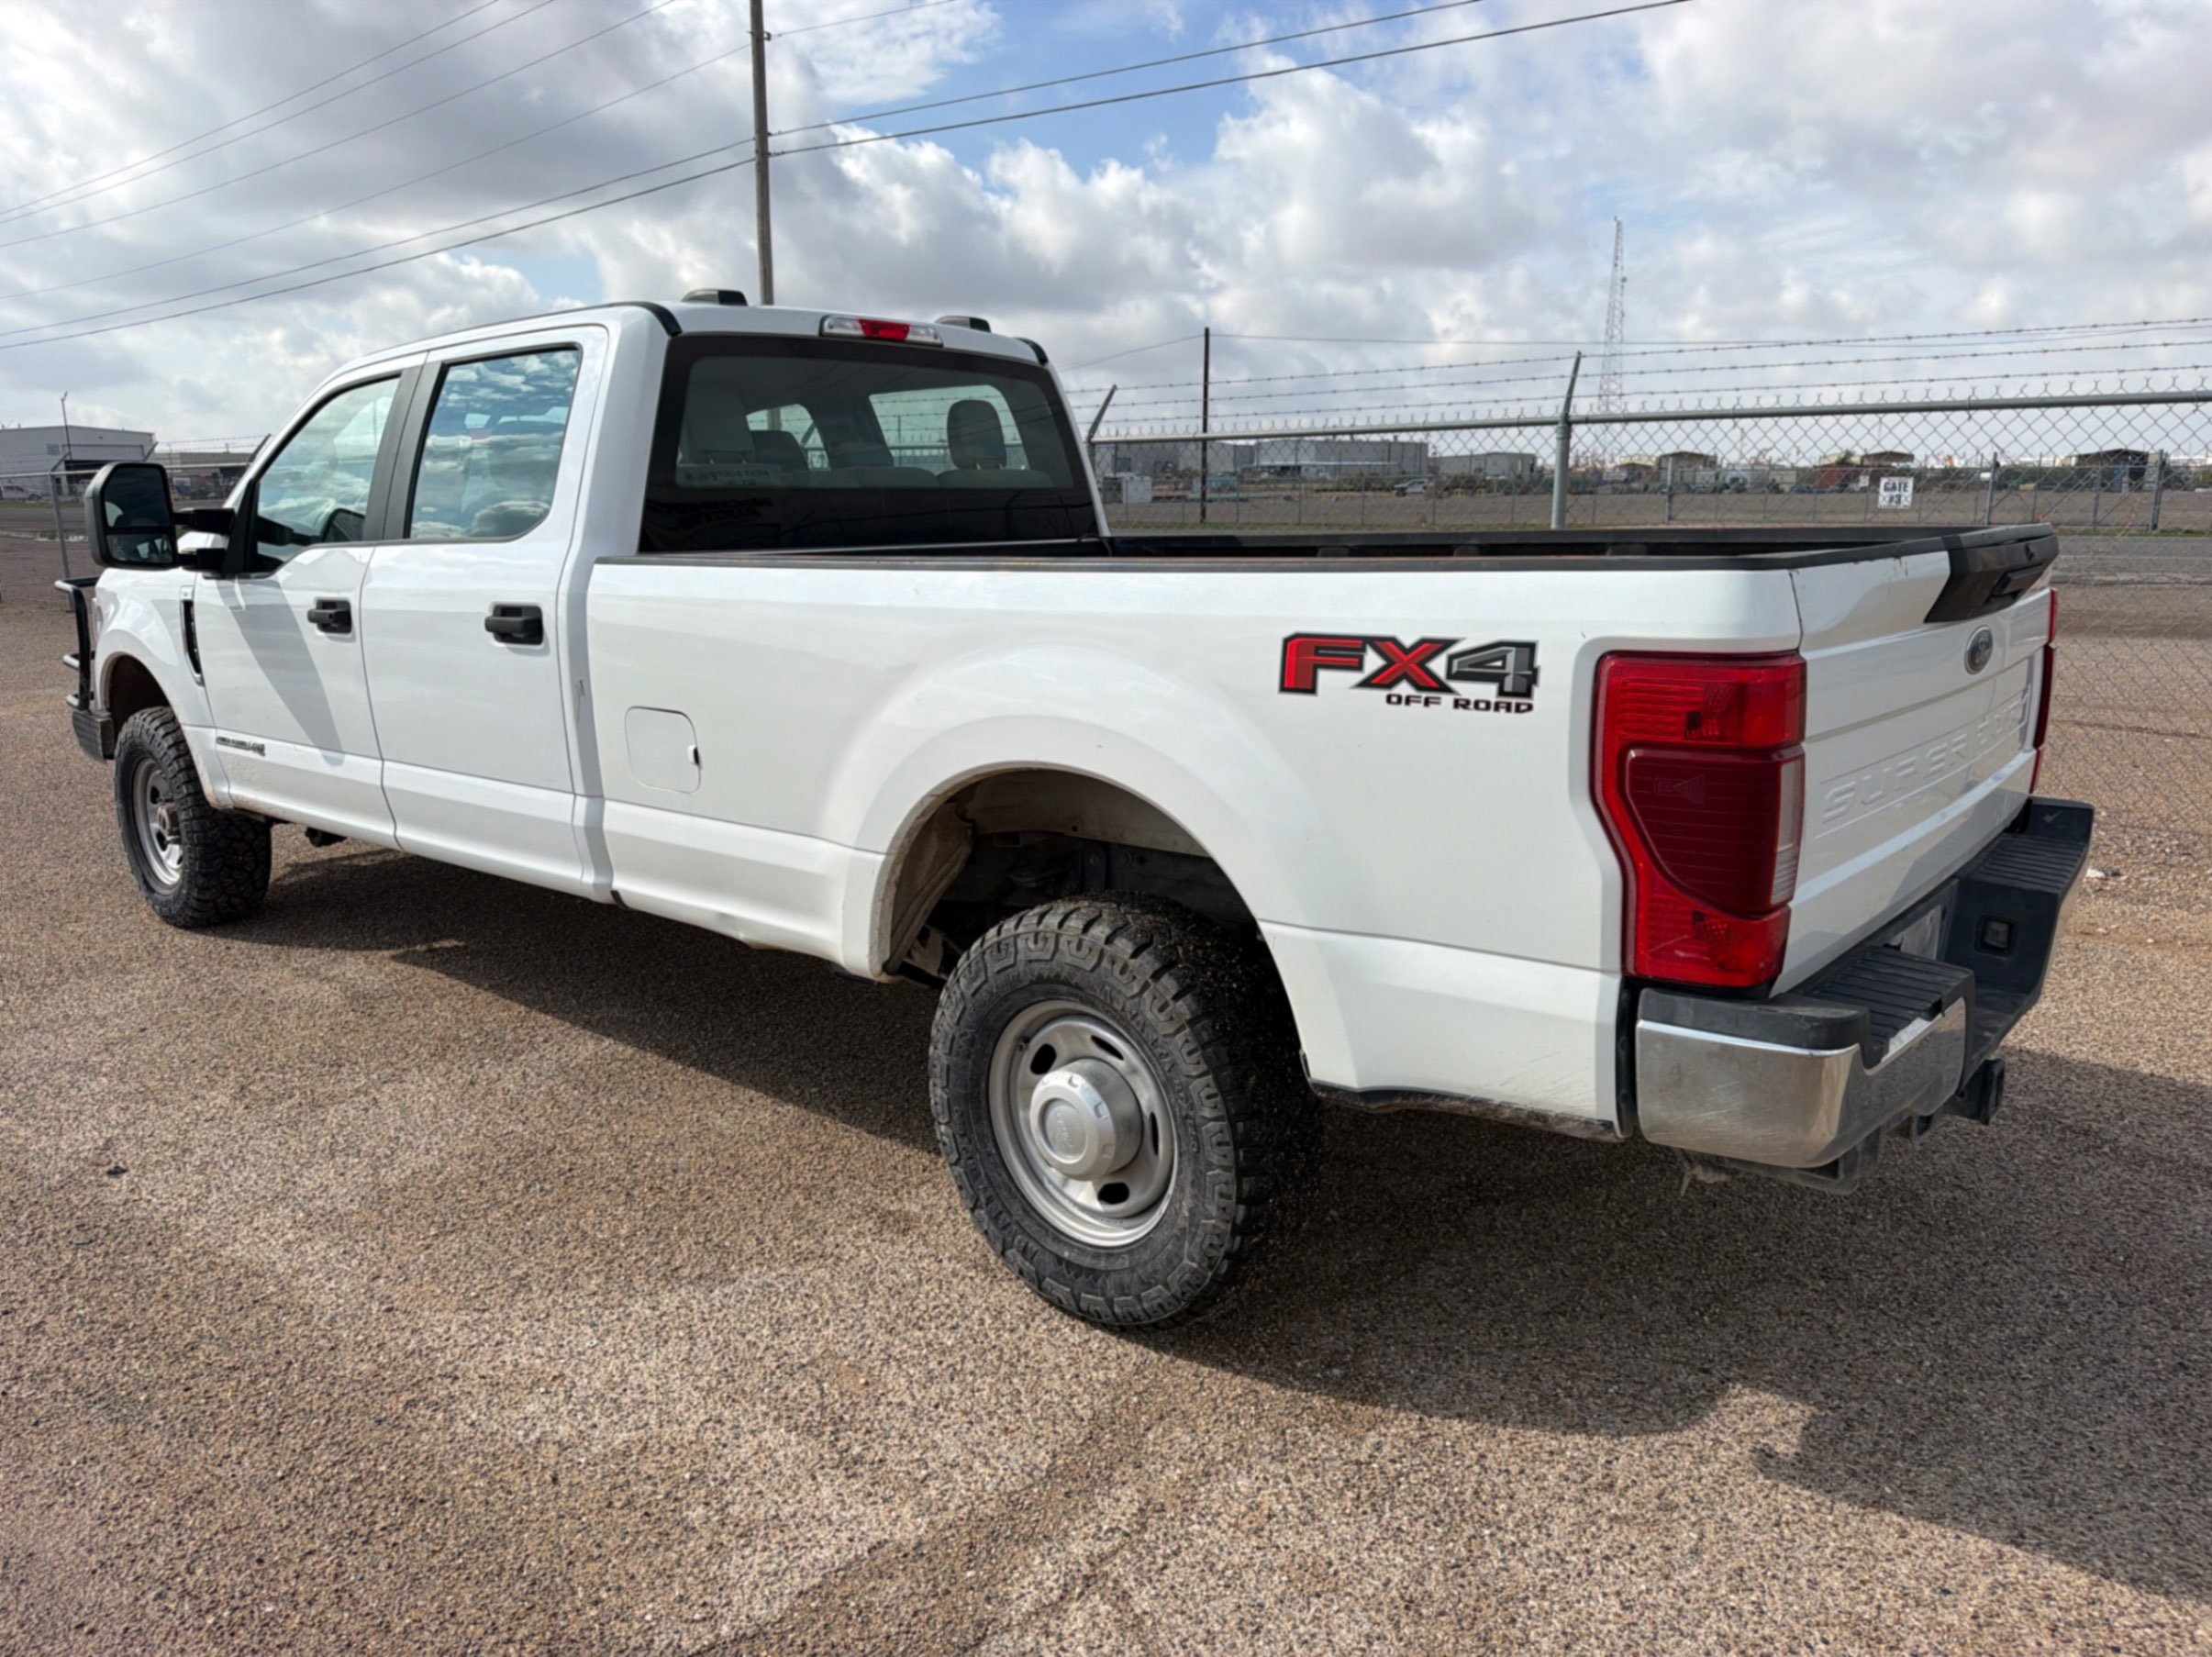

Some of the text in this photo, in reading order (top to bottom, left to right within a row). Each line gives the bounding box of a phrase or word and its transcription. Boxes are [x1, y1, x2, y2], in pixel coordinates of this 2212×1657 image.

[1884, 482, 1909, 493] GATE
[1278, 632, 1540, 700] FX4
[1385, 694, 1534, 714] OFF ROAD
[1821, 733, 1968, 824] SUPER
